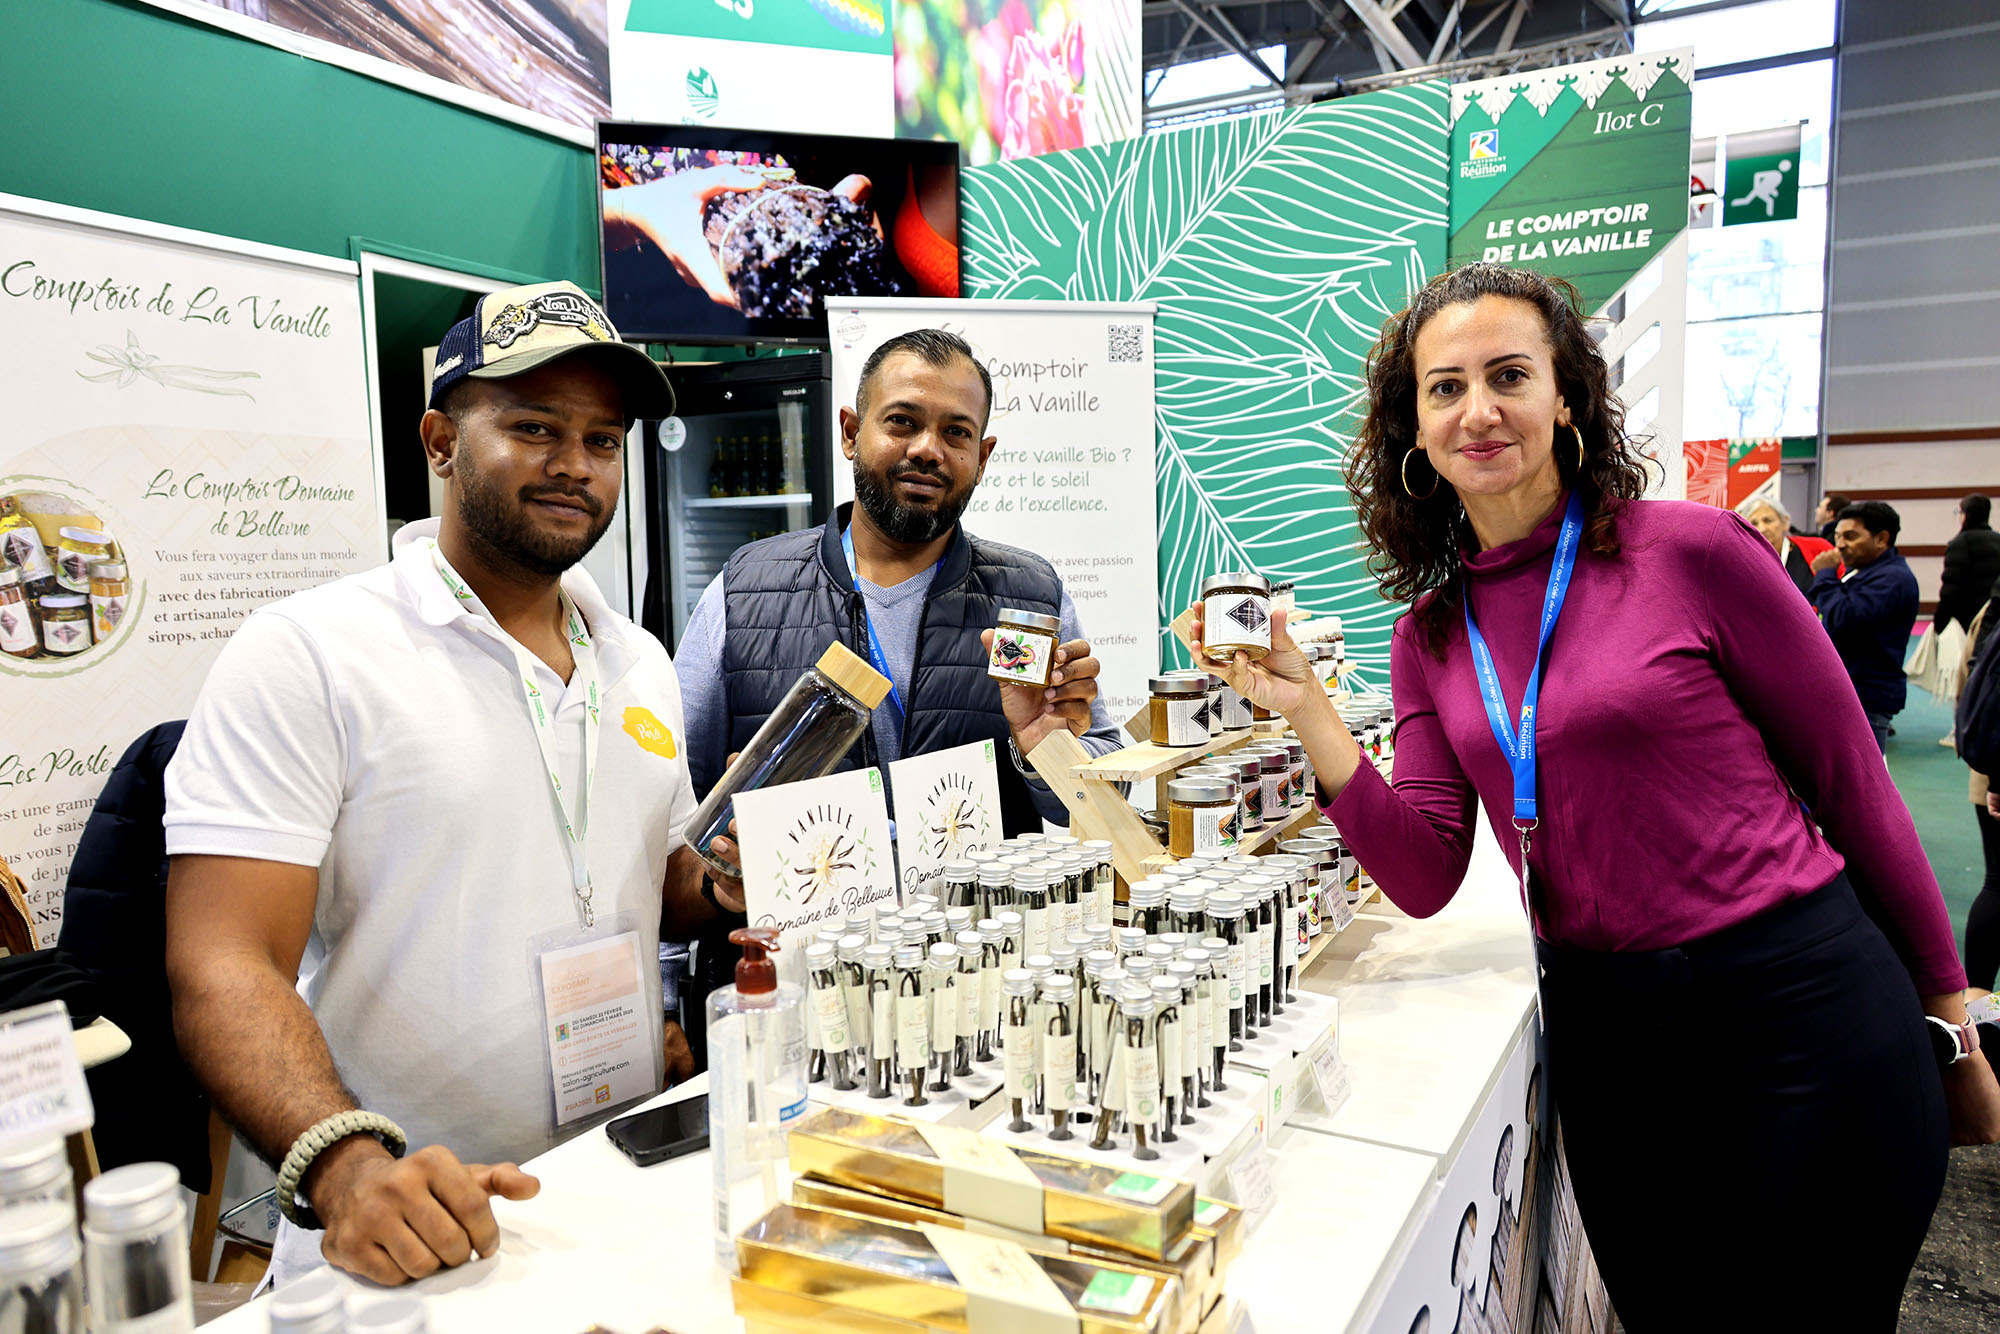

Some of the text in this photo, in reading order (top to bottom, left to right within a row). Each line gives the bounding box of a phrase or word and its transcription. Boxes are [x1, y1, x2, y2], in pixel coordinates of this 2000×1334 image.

[1593, 103, 1664, 135] Ilot C
[1460, 162, 1507, 178] Réunion
[1486, 203, 1650, 240] LE COMPTOIR
[1482, 228, 1654, 265] DE LA VANILLE
[1, 261, 332, 339] Comptoir de La Vanille
[987, 357, 1089, 384] Comptoir
[994, 391, 1100, 413] La Vanille
[1089, 447, 1117, 464] Bio
[1122, 447, 1132, 463] ?
[141, 468, 355, 506] Le Comptoir Domaine
[1008, 471, 1028, 488] et
[1033, 471, 1046, 488] le
[1051, 470, 1090, 488] soleil
[995, 495, 1015, 512] de
[210, 509, 311, 538] de Bellevue
[155, 548, 357, 565] Vous fera voyager dans un monde
[1065, 557, 1090, 567] avec
[1093, 555, 1134, 569] passion
[179, 567, 341, 583] aux saveurs extraordinaire
[1068, 574, 1100, 583] serres
[159, 591, 190, 603] avec
[194, 588, 217, 602] des
[154, 612, 168, 623] et
[173, 608, 245, 622] artisanales
[148, 629, 197, 646] sirops,
[1093, 634, 1138, 646] certifiée
[1127, 695, 1145, 707] bio
[1519, 722, 1529, 760] Réunion
[927, 772, 974, 806] VANILLE
[22, 805, 51, 818] une
[33, 823, 52, 838] de
[788, 804, 854, 844] VANILLE
[27, 845, 62, 860] vous
[31, 866, 50, 882] de
[824, 898, 840, 918] de
[841, 884, 894, 916] Bellevue
[42, 931, 57, 945] et
[562, 1060, 630, 1088] salon-agriculture.com
